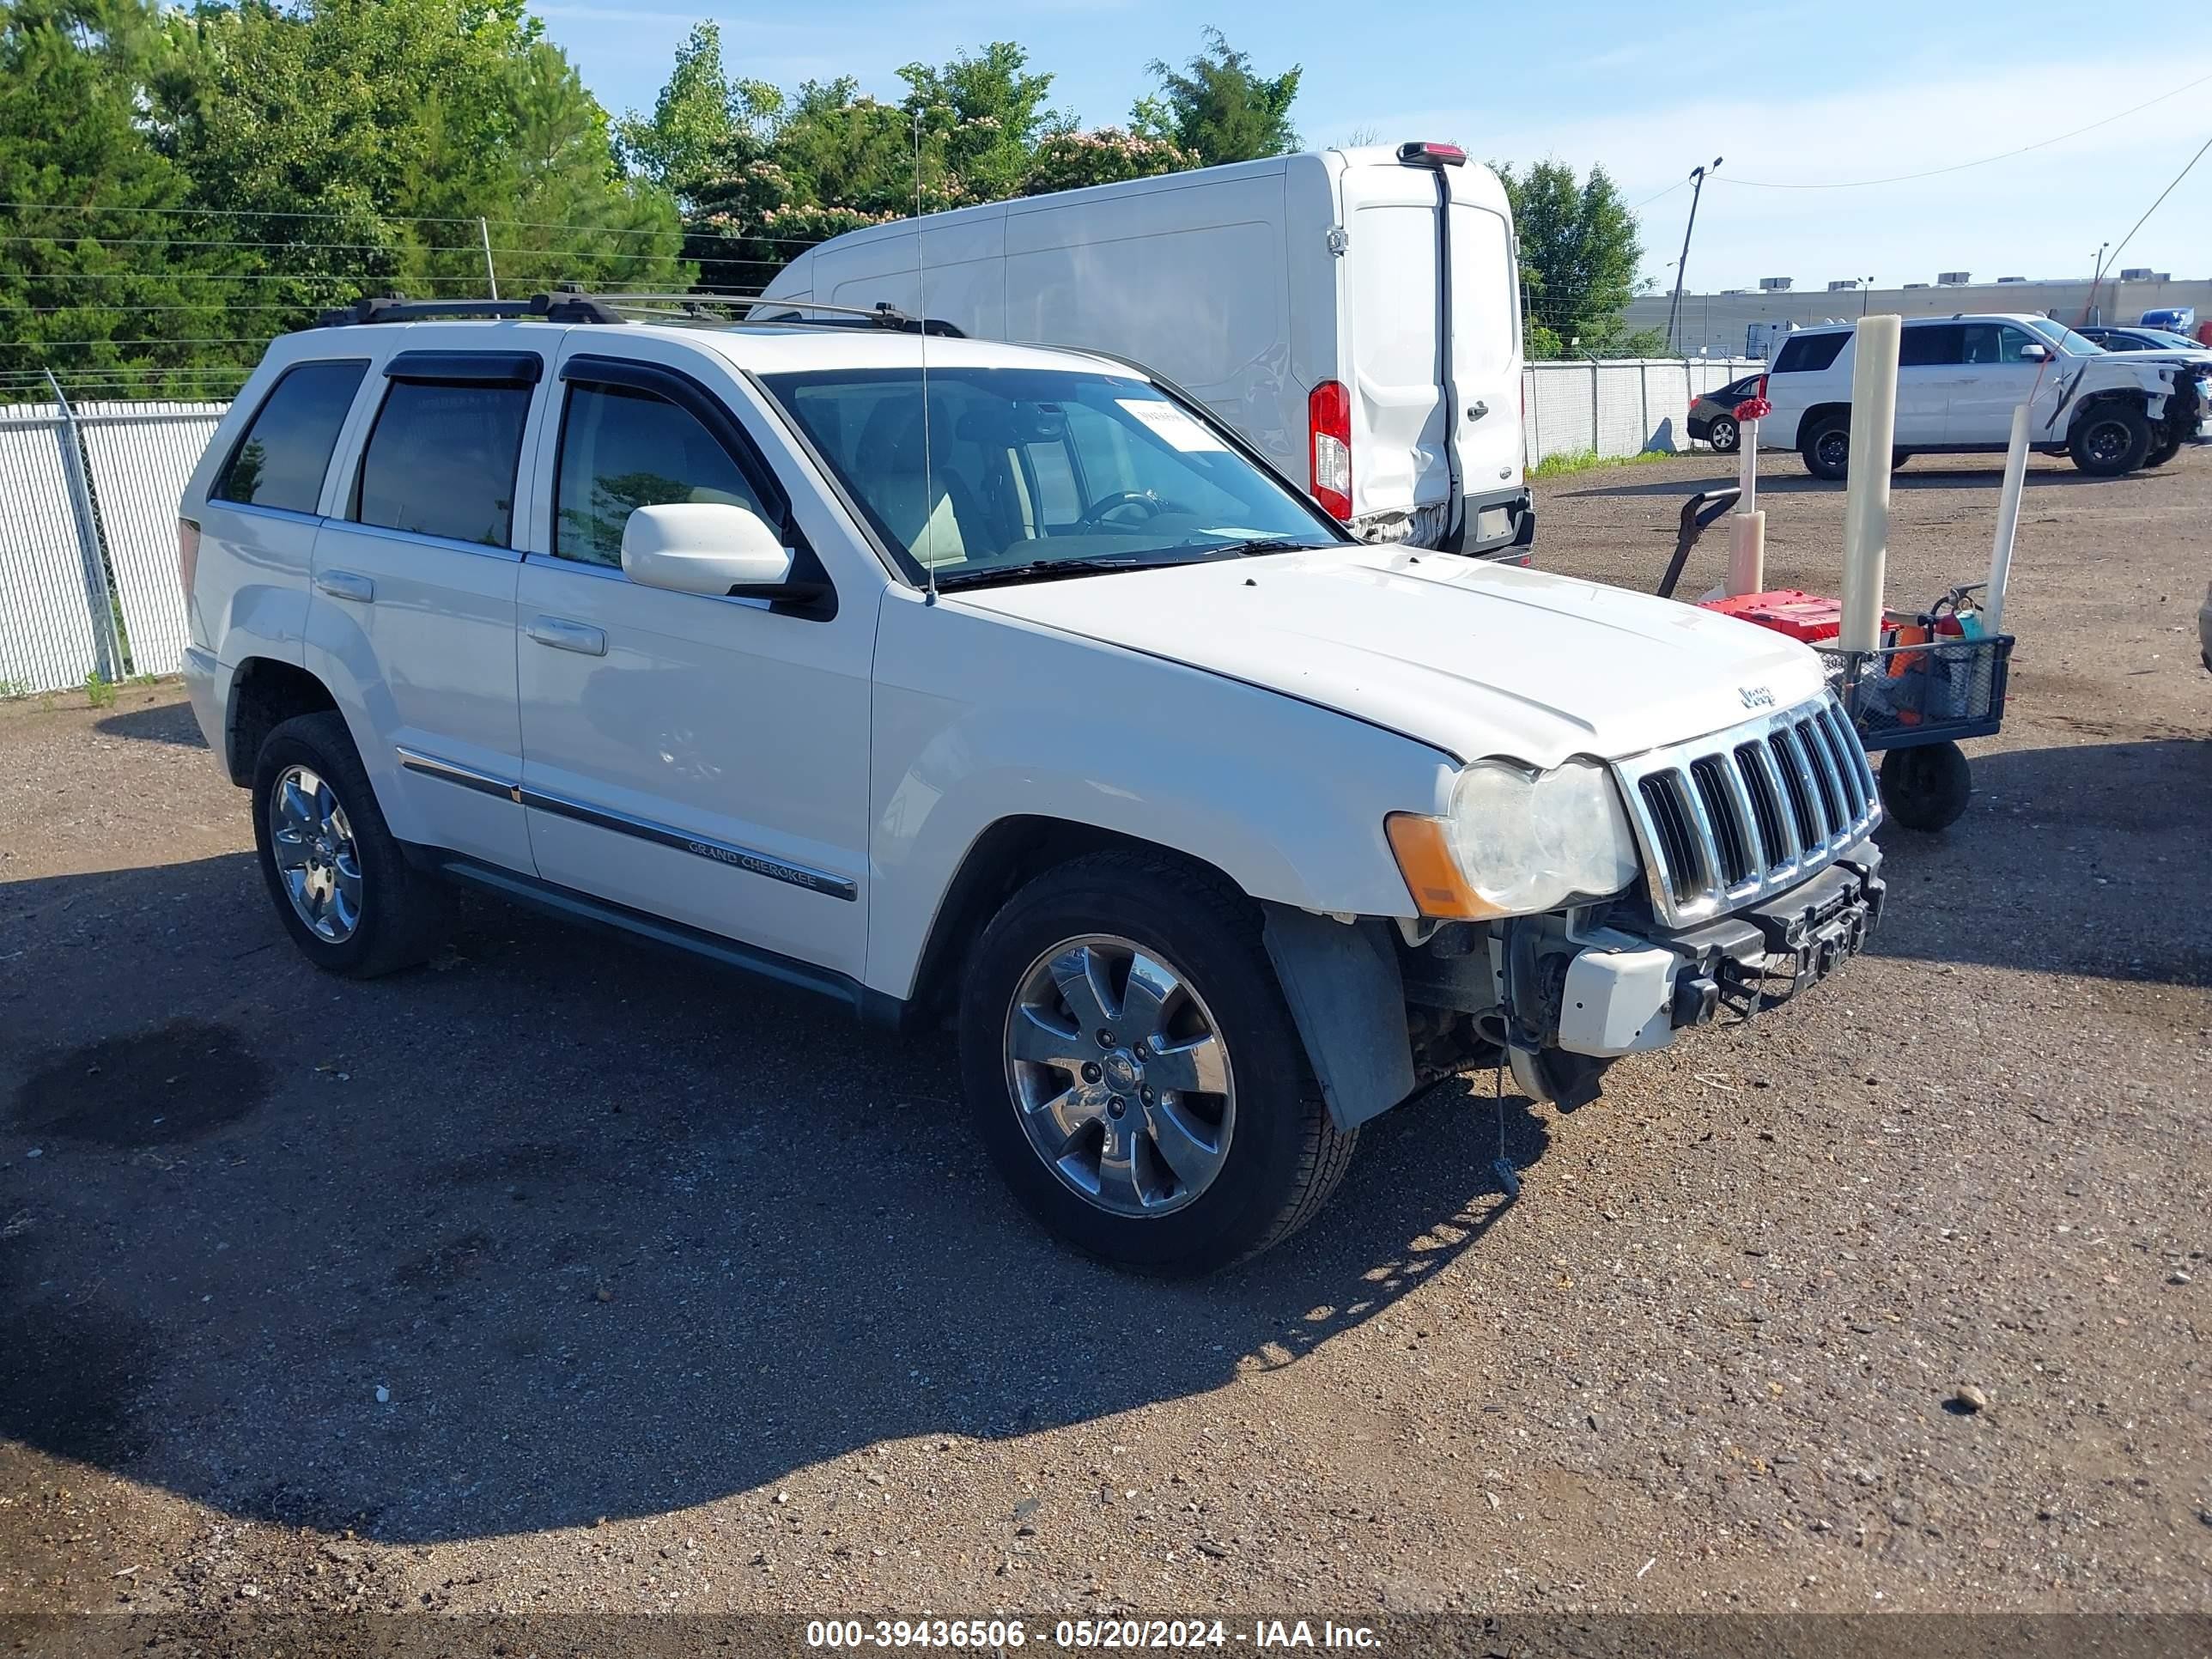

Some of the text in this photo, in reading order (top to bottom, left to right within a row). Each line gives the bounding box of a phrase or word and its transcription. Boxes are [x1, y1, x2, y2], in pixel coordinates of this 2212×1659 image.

[1737, 685, 1776, 710] Jeep
[689, 842, 817, 887] GRAND CHEROKEE
